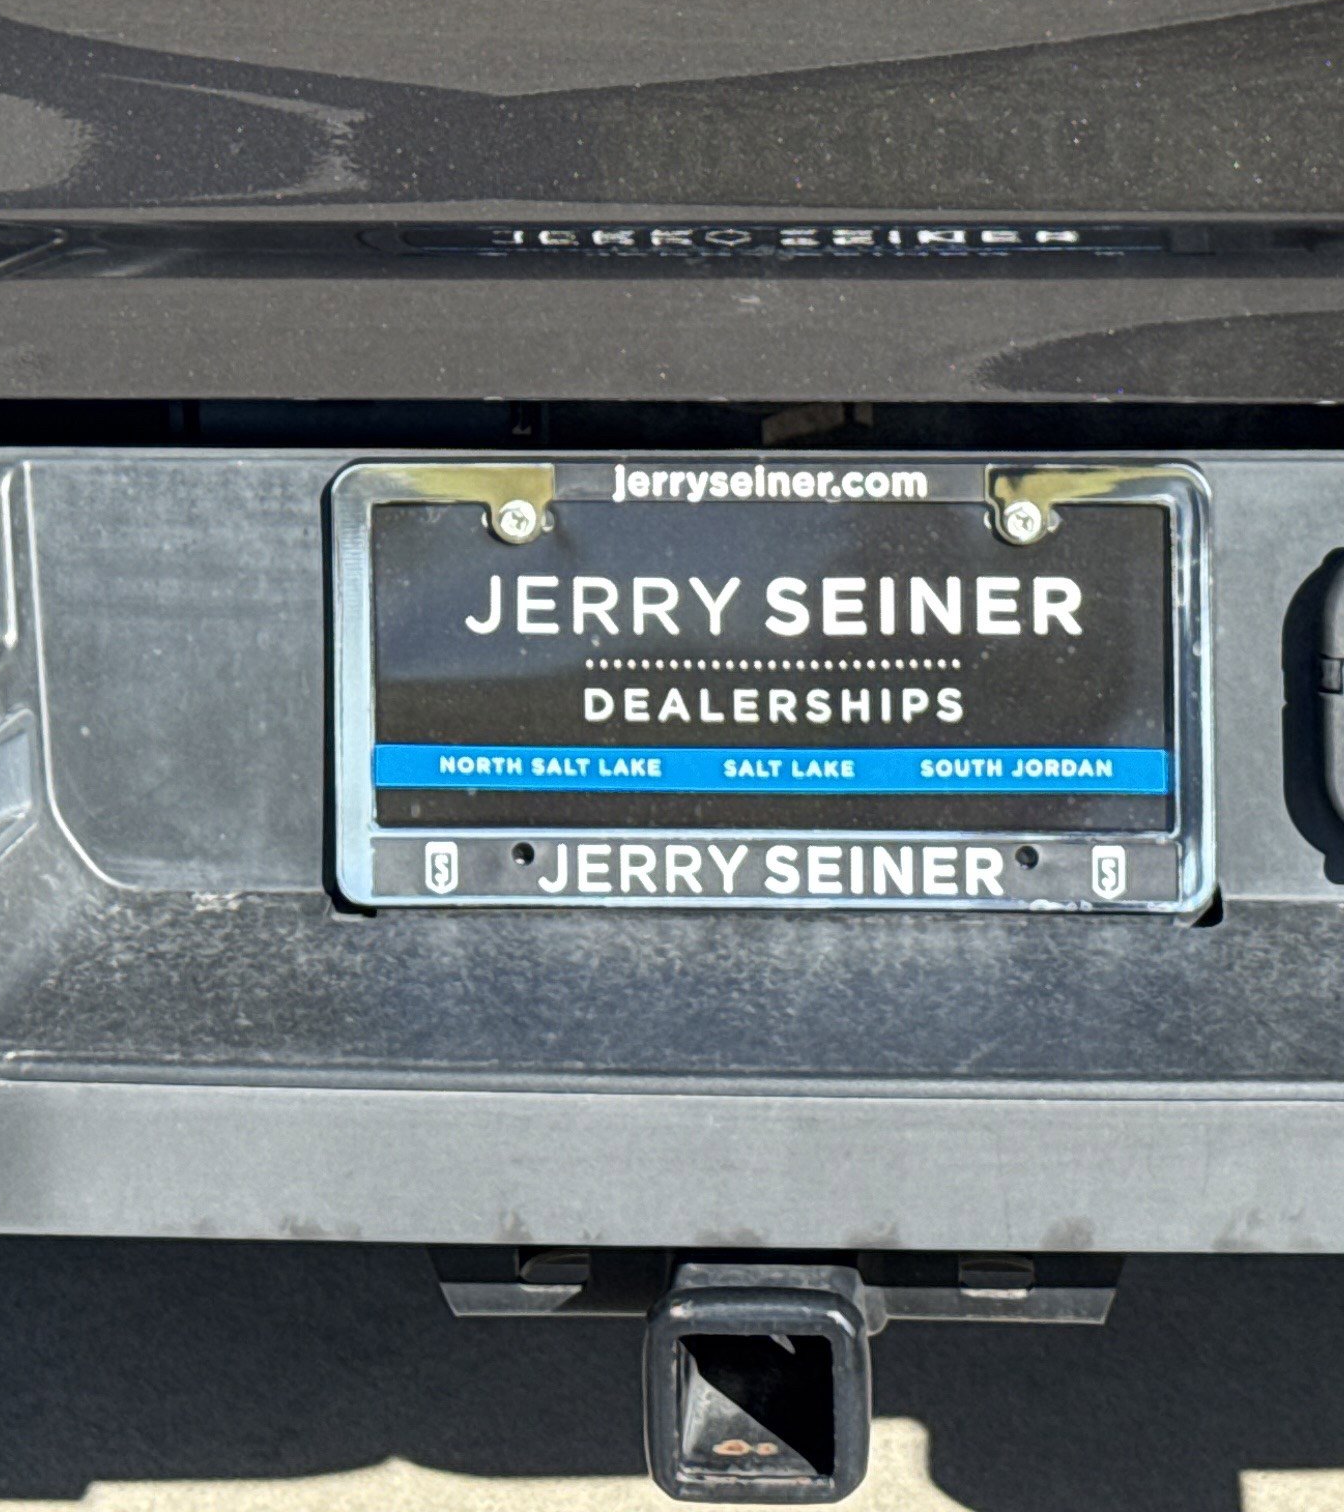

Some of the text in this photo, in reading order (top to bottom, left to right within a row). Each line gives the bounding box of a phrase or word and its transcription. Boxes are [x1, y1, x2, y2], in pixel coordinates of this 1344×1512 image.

[613, 464, 927, 502] jerryseiner.com
[465, 575, 1083, 636] JERRY SEINER
[584, 687, 963, 723] DEALERSHIPS
[439, 756, 662, 777] NORTH SALT LAKE
[723, 760, 855, 778] SALT LAKE
[920, 759, 1113, 778] SOUTH JORDAN
[538, 843, 1004, 896] JERRY SEINER
